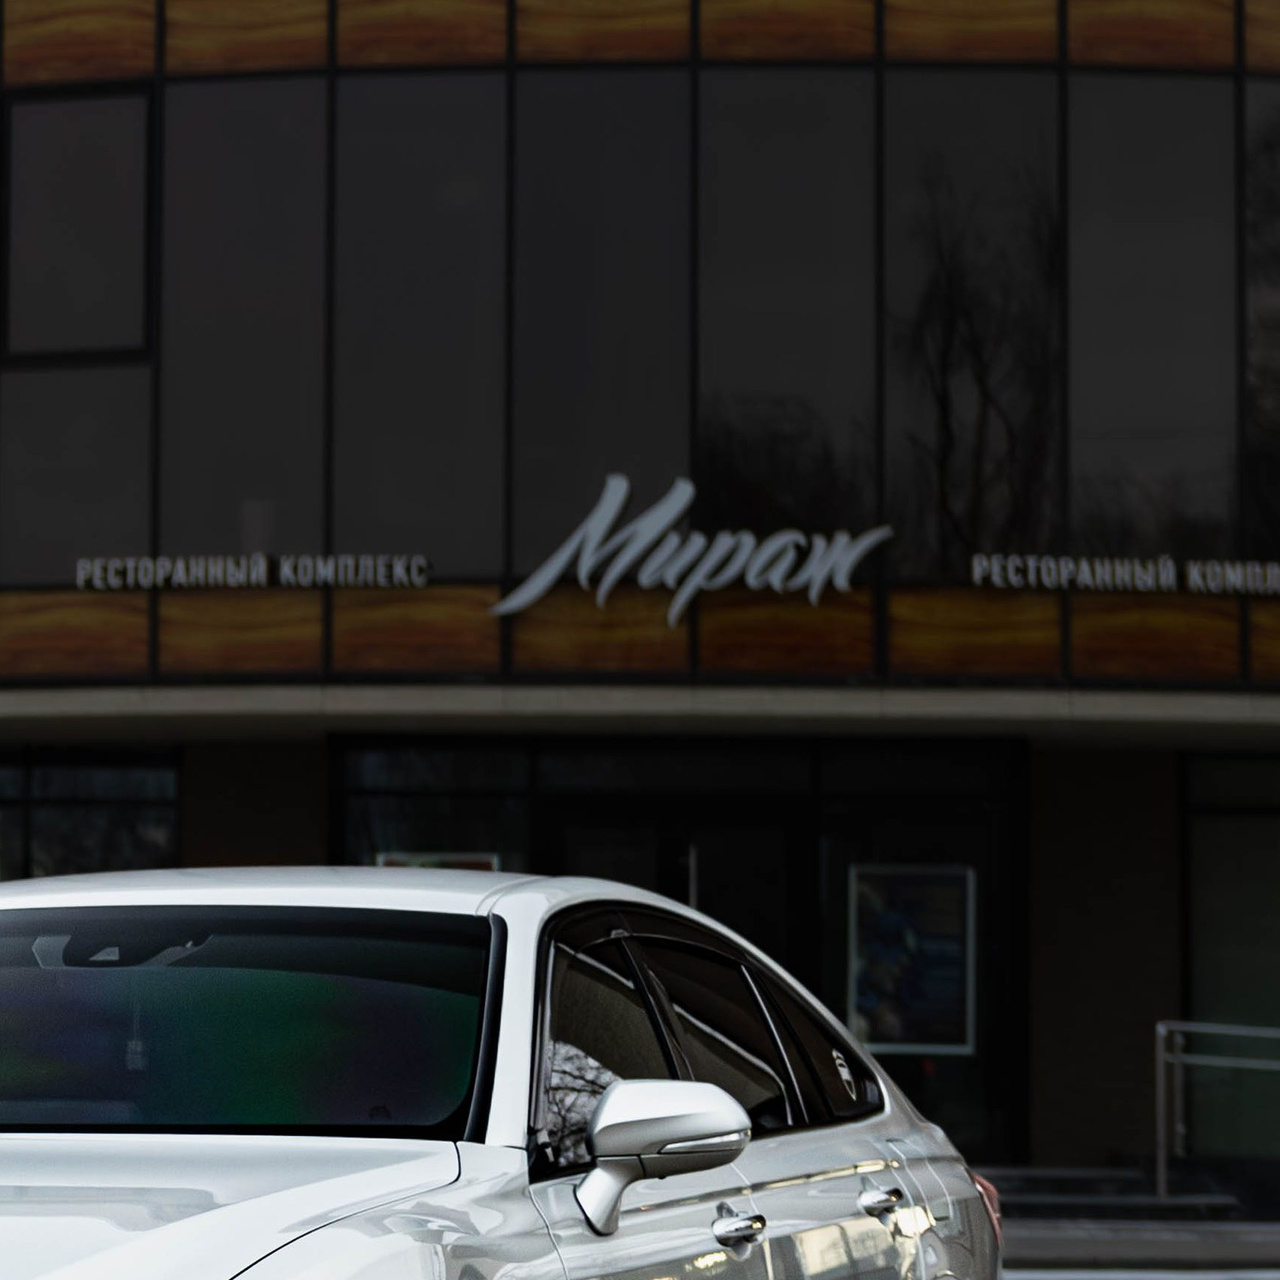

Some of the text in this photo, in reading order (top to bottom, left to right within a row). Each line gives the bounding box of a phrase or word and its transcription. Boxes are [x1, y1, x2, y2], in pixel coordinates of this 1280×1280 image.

[489, 472, 895, 629] Мираж
[76, 553, 429, 589] РЕСТОРАННЫЙ КОМПЛЕКС
[972, 553, 1177, 592] РЕСТОРАННЫЙ
